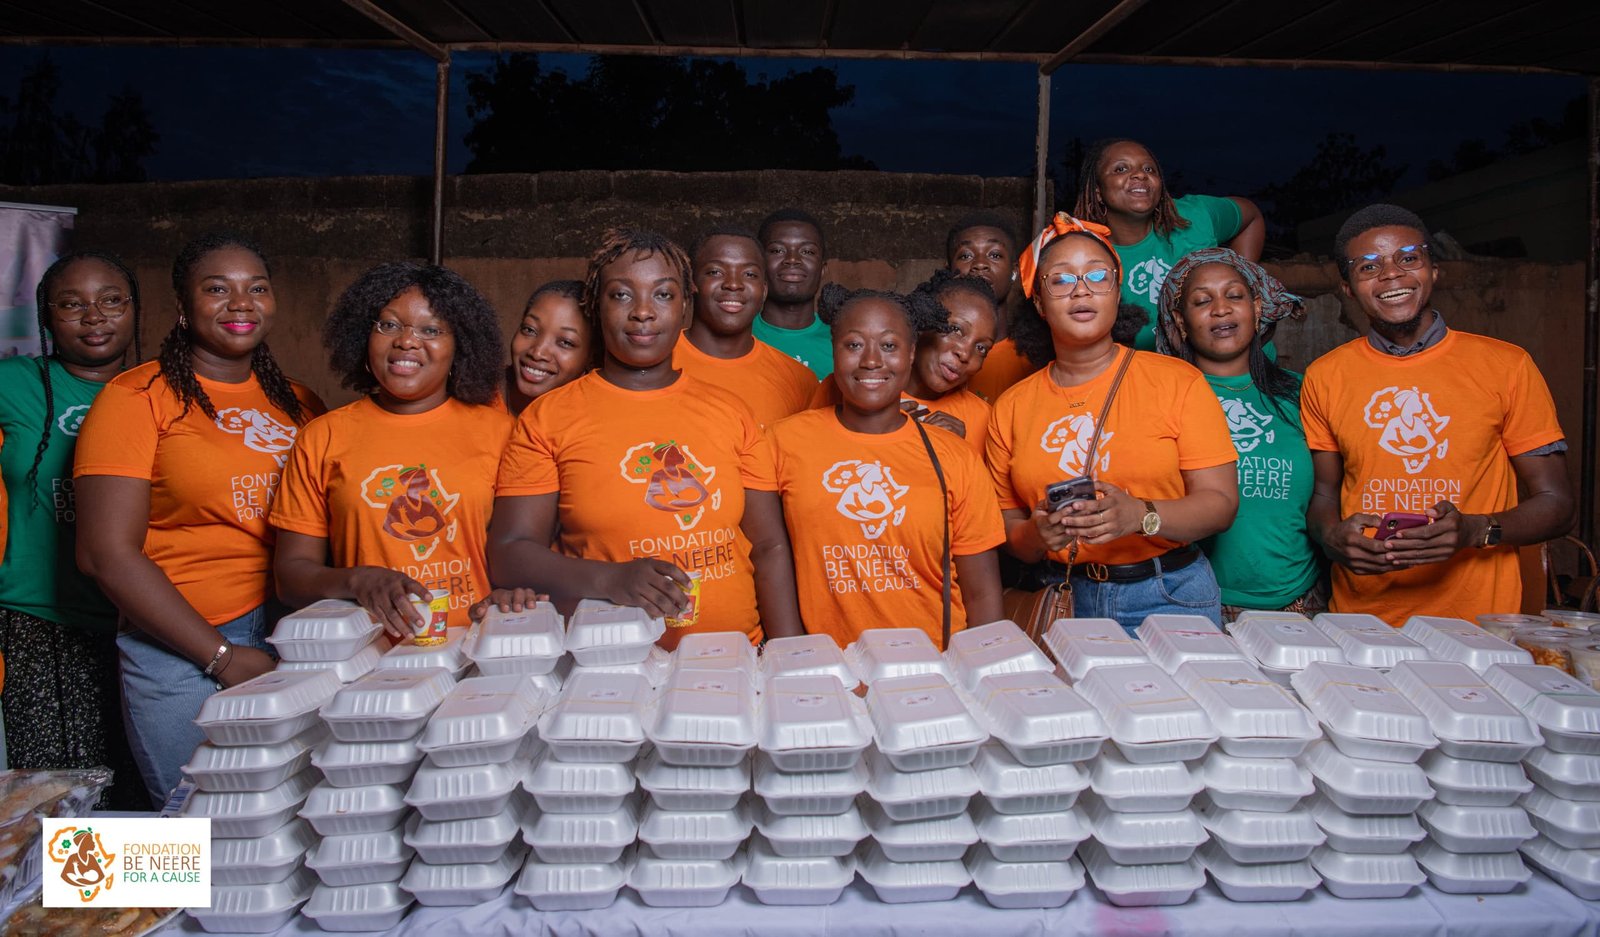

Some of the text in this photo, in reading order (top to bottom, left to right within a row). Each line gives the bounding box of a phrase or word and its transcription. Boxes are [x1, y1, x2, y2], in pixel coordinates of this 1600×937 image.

[1238, 469, 1292, 488] ËËRE
[233, 489, 259, 509] BE
[1242, 486, 1290, 500] CAUSE
[1362, 493, 1386, 510] BE
[237, 507, 265, 523] FOR
[629, 528, 735, 555] FONDATION
[823, 544, 910, 560] FONDATION
[825, 560, 852, 579] BE
[829, 576, 921, 594] FOR A CAUSE
